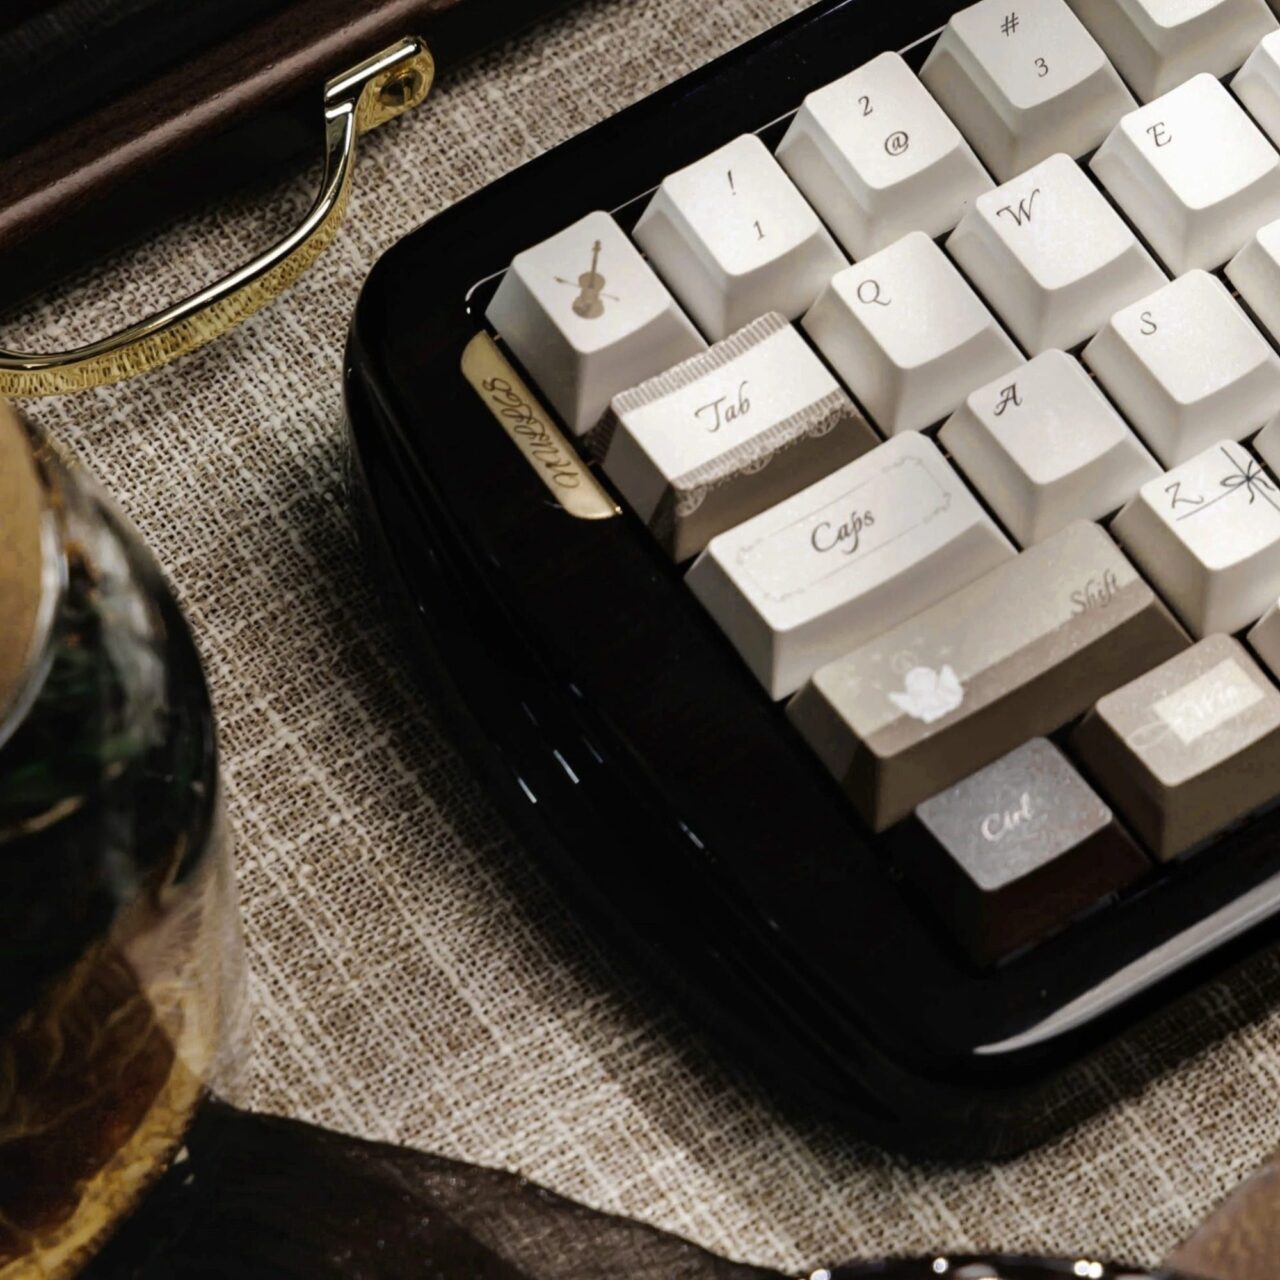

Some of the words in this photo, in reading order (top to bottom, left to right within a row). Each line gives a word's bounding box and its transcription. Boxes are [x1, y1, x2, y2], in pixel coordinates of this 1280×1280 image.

[1000, 11, 1020, 37] #
[1034, 57, 1049, 78] 3
[857, 95, 874, 117] 2
[883, 130, 910, 157] @
[1145, 121, 1172, 148] E
[726, 169, 740, 199] !
[994, 186, 1041, 228] W
[753, 220, 765, 241] 1
[856, 279, 892, 307] Q
[1140, 311, 1158, 336] S
[693, 380, 751, 433] Tab
[993, 382, 1021, 417] A
[1164, 481, 1205, 511] Z
[810, 510, 875, 555] Caps
[1069, 568, 1119, 616] Shift
